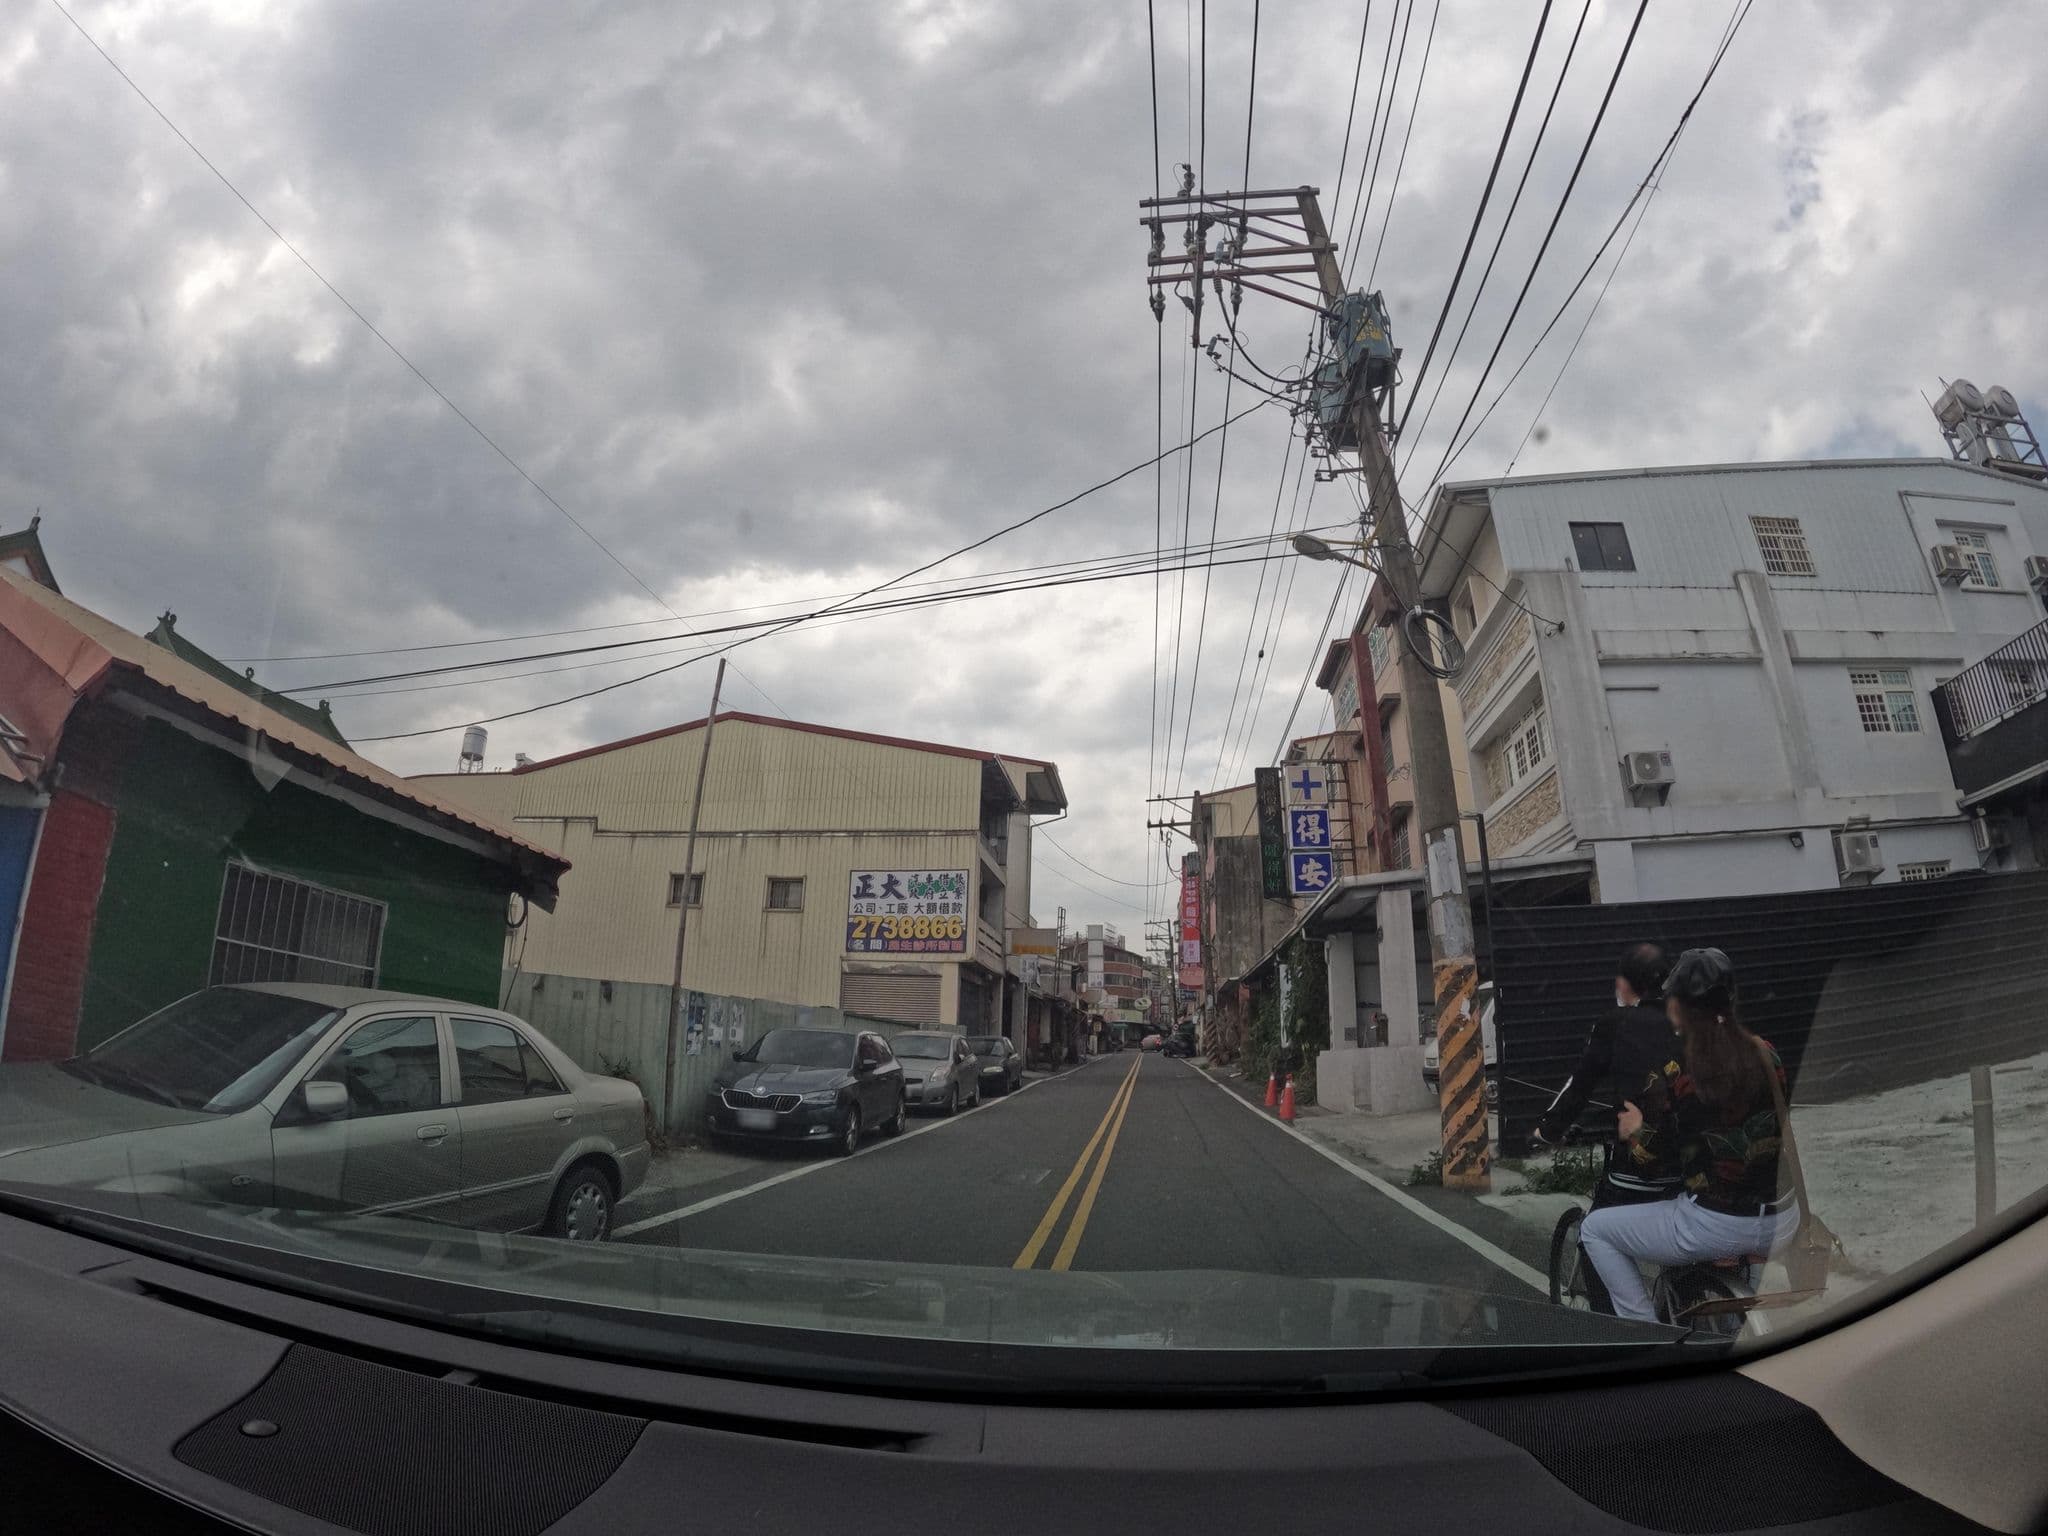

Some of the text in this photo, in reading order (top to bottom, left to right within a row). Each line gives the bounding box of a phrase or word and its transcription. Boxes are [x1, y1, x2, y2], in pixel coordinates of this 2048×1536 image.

[1296, 814, 1328, 887] 得安
[853, 873, 906, 900] 正大
[914, 903, 963, 914] 大額借款
[851, 915, 964, 939] 2738866
